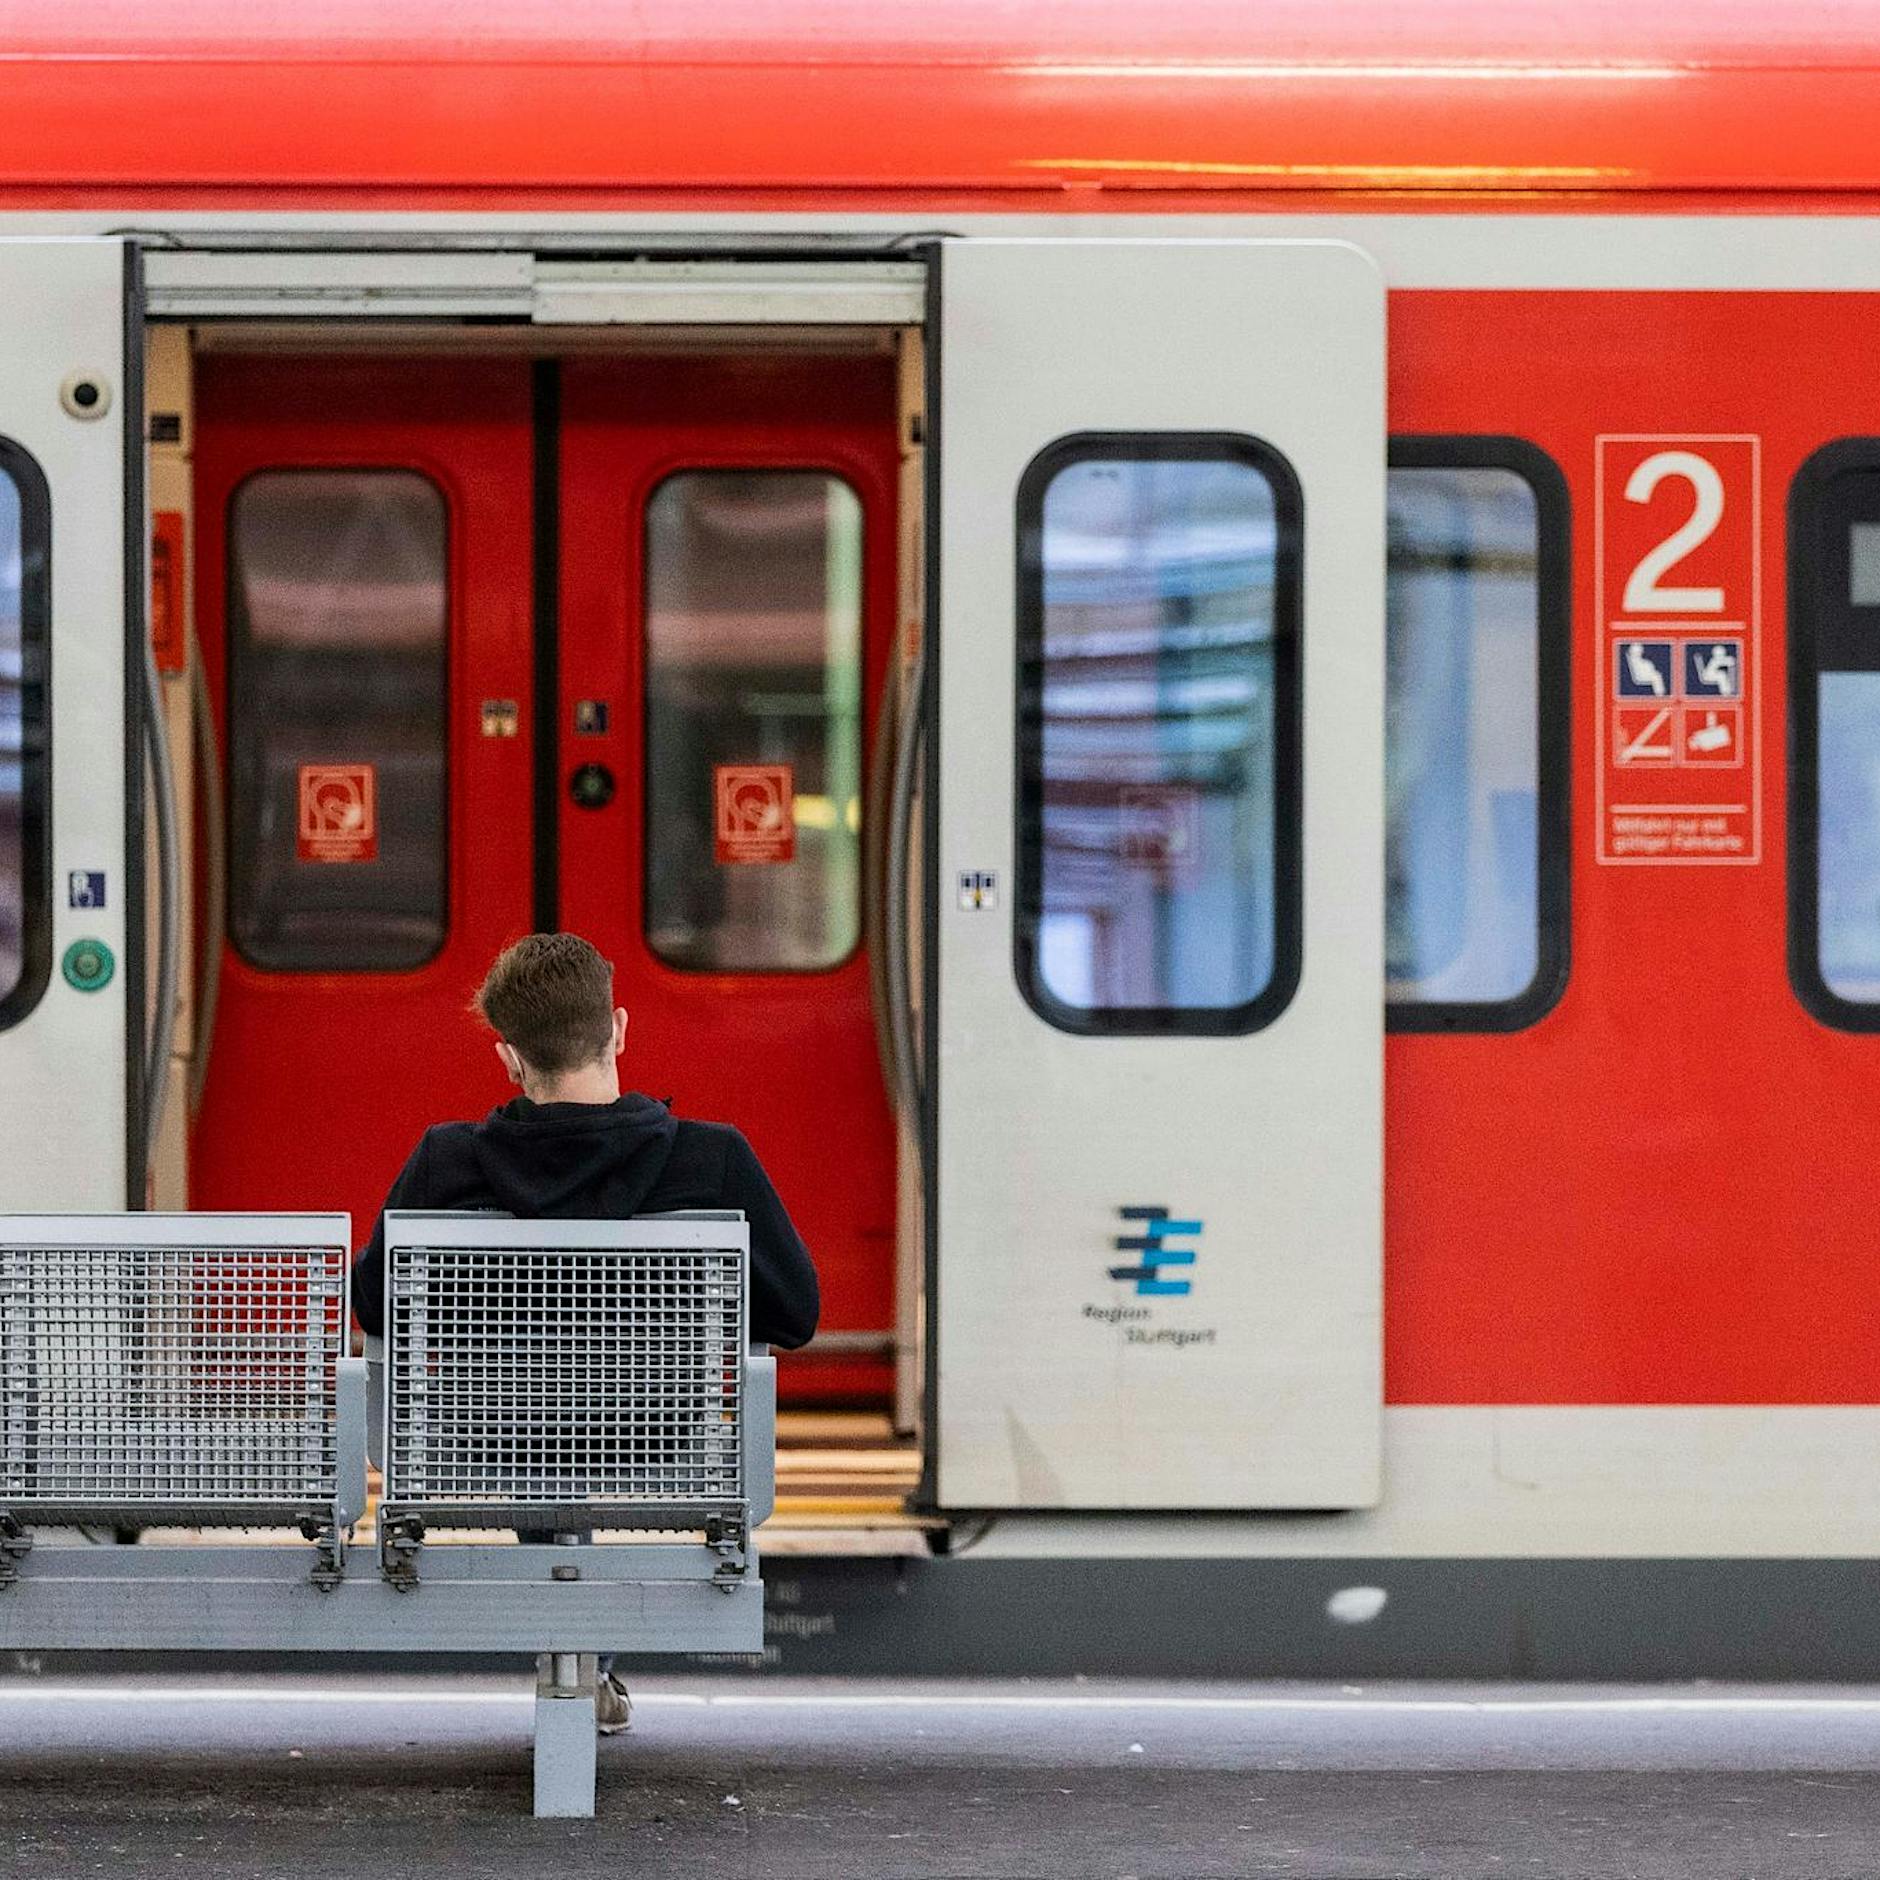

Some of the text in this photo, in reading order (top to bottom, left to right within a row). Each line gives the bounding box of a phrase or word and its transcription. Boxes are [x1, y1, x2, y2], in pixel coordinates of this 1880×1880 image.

[1622, 451, 1725, 613] 2
[1082, 1303, 1151, 1323] Region
[1126, 1326, 1216, 1346] Stuttgart
